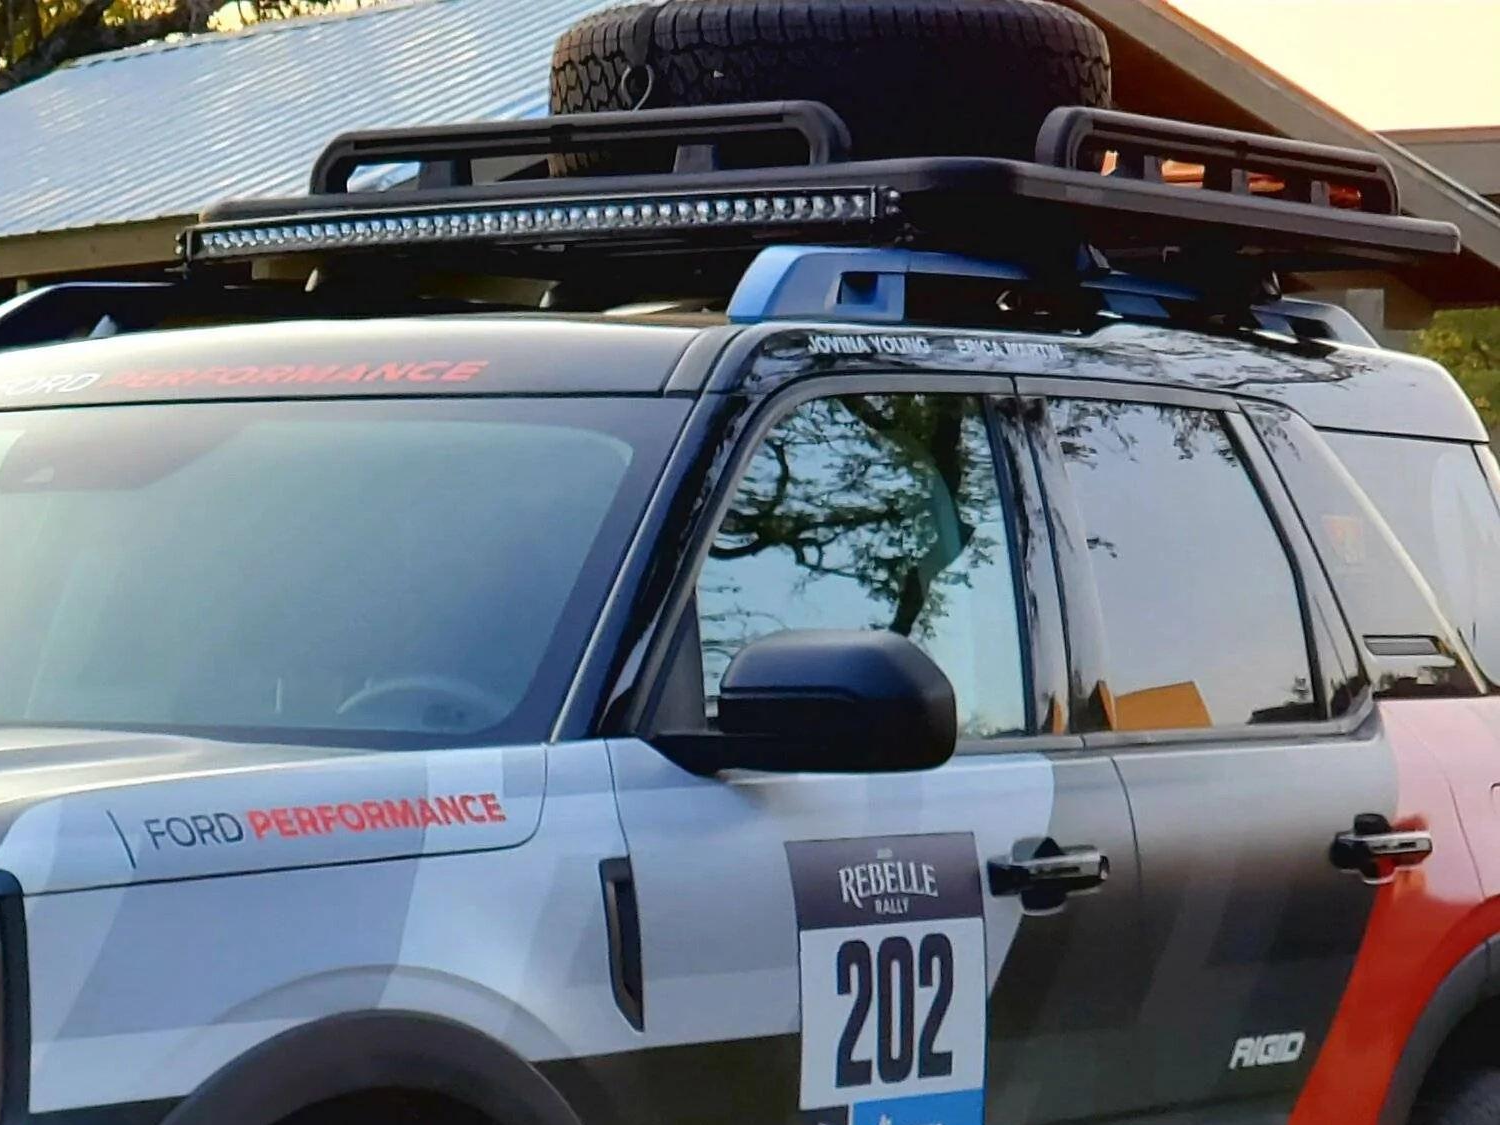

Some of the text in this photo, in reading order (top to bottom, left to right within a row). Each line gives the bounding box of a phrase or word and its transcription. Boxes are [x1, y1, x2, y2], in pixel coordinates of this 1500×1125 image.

[101, 360, 489, 389] PERFORMANCE
[144, 793, 506, 851] FORD PERFORMANCE
[838, 861, 939, 909] REBELLE
[874, 897, 909, 914] RALLY
[835, 933, 954, 1089] 202
[1229, 1031, 1306, 1070] RIGID
